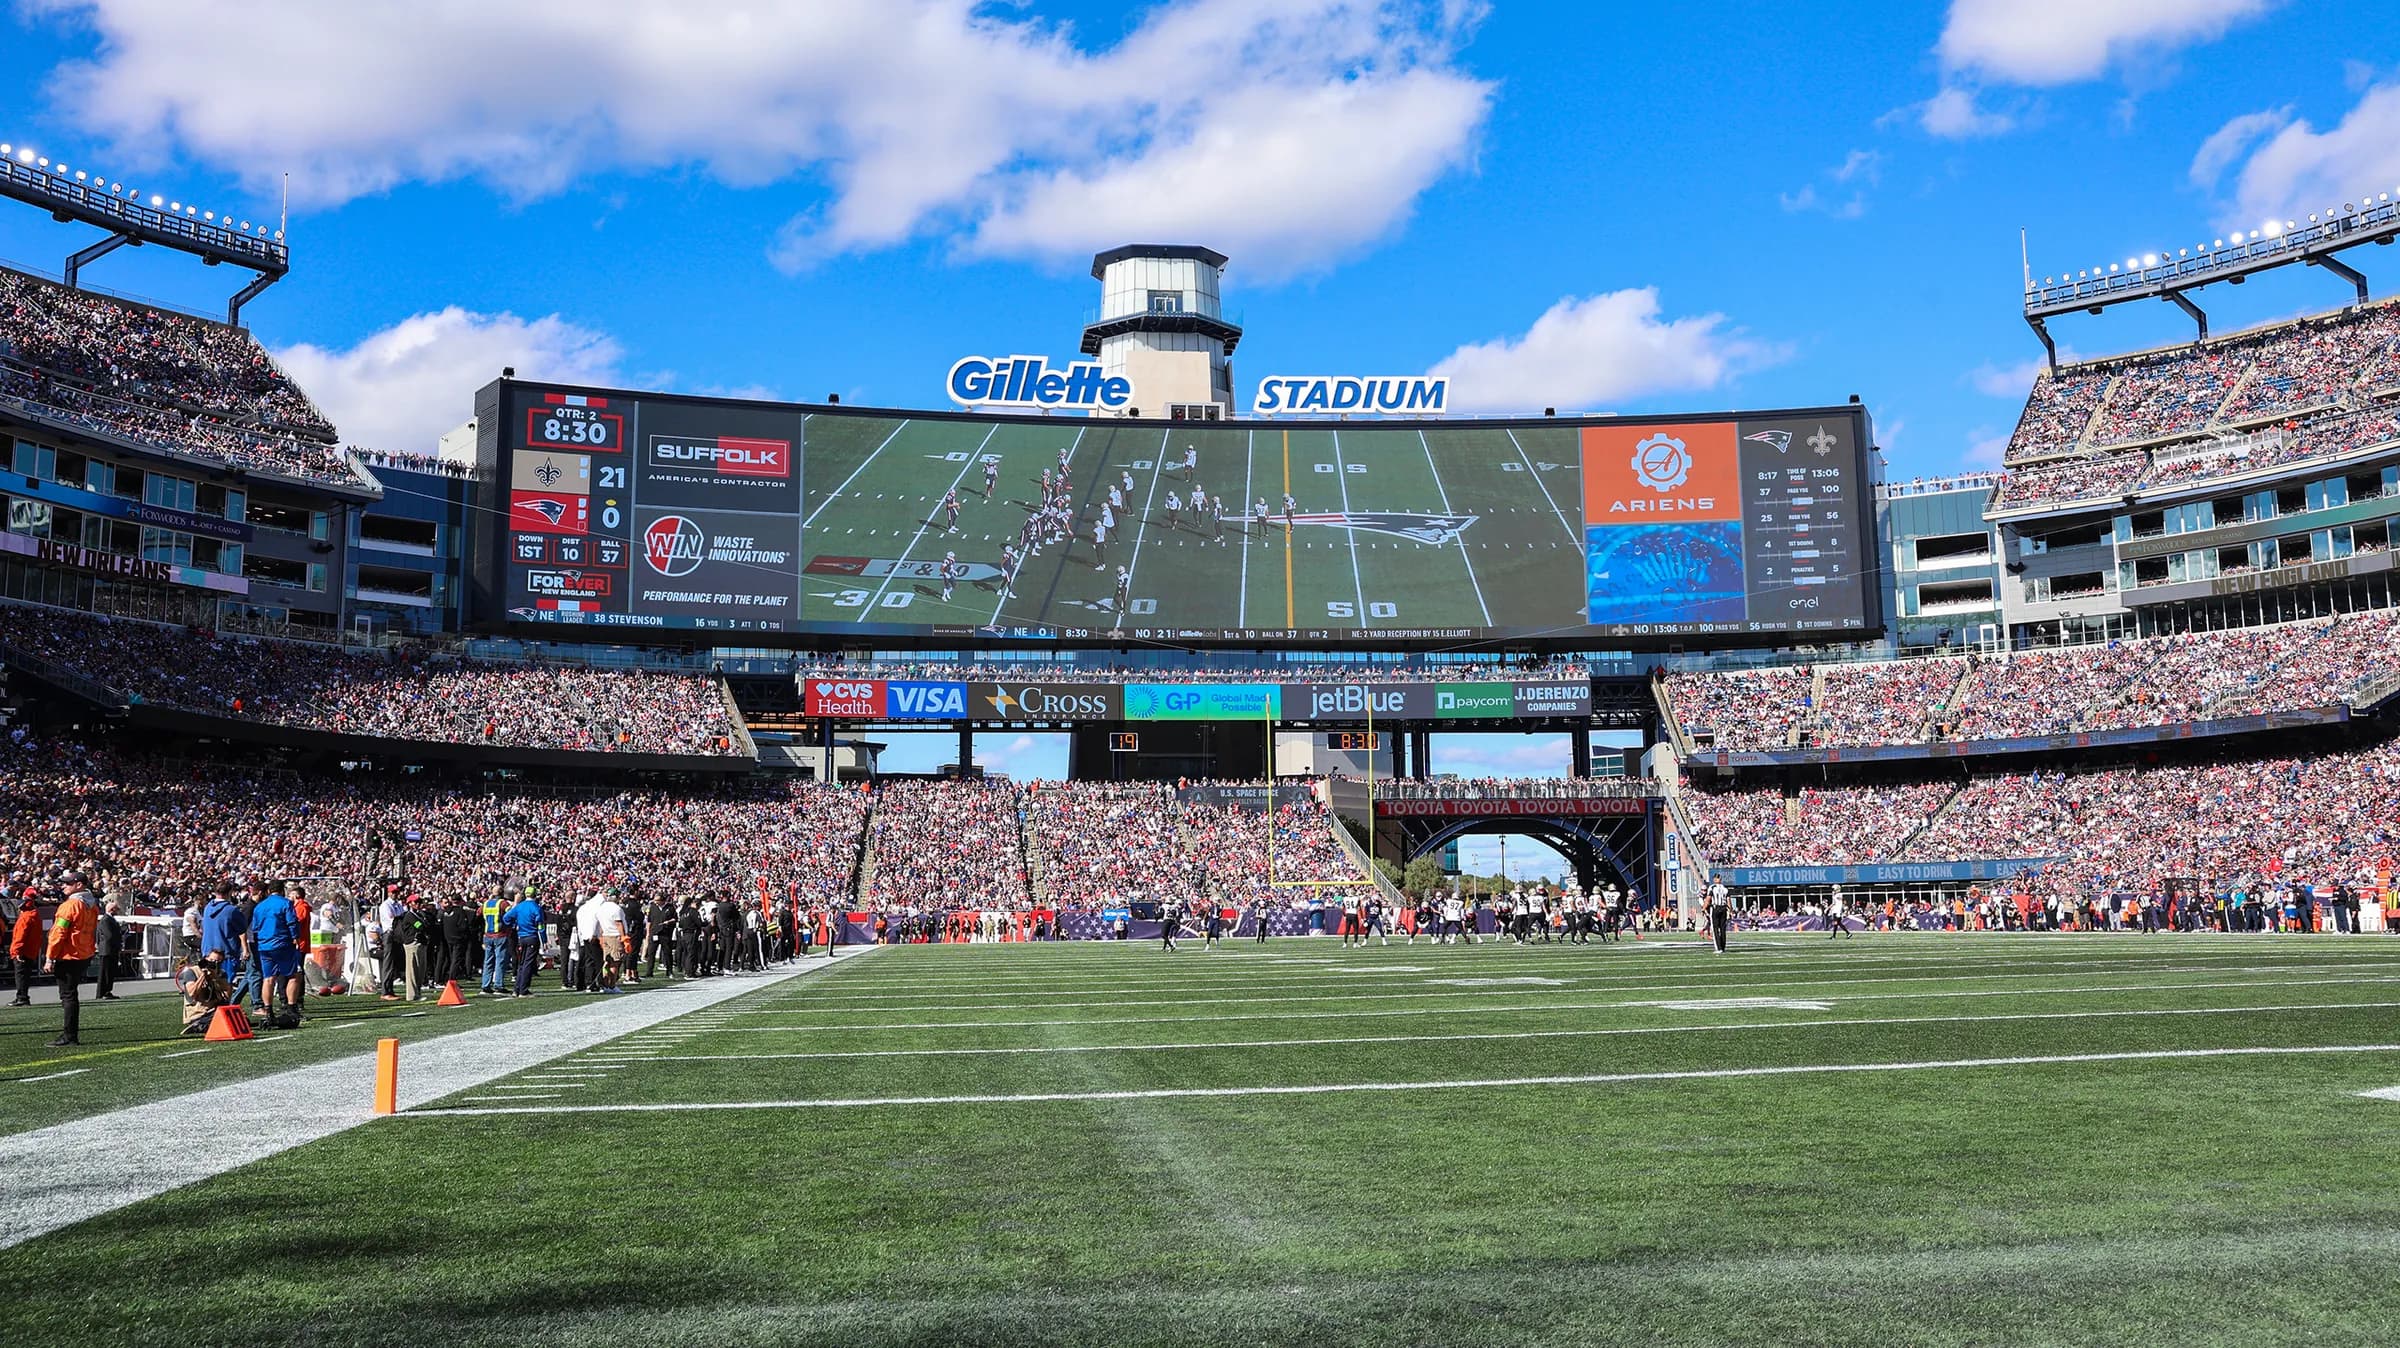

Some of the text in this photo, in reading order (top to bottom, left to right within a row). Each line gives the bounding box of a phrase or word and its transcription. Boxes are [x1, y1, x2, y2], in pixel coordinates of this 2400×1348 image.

[950, 357, 1446, 411] Gillette STADIUM
[555, 408, 597, 420] QTR: 2
[544, 419, 607, 444] 8:30
[656, 444, 778, 465] SUFFOLK
[599, 466, 625, 489] 21
[649, 474, 786, 488] AMERICA'S CONTRACTOR
[1758, 472, 1778, 480] 8:17
[1812, 469, 1839, 478] 13:06
[1760, 488, 1771, 496] 37
[1822, 485, 1839, 493] 100
[1609, 497, 1713, 513] ARIENS
[141, 508, 186, 526] FOXWOODS
[218, 526, 241, 535] CASINO
[602, 508, 620, 529] 0
[519, 535, 620, 548] DOWN DIST BALL
[713, 535, 754, 549] WASTE
[39, 539, 171, 582] NEW ORLEANS
[518, 545, 619, 563] 1ST 10 37
[708, 548, 786, 564] INNOVATIONS
[915, 563, 933, 576] &
[1767, 567, 1773, 575] 2
[2212, 560, 2349, 594] NEW ENGLAND
[541, 588, 596, 598] NEW ENGLAND
[643, 590, 788, 607] PERFORMANCE FOR THE PLANET
[1789, 596, 1819, 608] enel
[539, 610, 554, 621] NE
[562, 616, 583, 624] LEADER
[594, 613, 663, 626] 38 STEVENSON
[695, 618, 705, 628] 16
[729, 619, 735, 629] 3
[741, 620, 751, 628] ATT
[760, 620, 767, 630] 0
[1634, 624, 1649, 634] NO
[1654, 624, 1678, 633] 13:06
[1699, 623, 1714, 632] 100
[1750, 622, 1760, 630] 56
[1797, 620, 1802, 629] 8
[1843, 619, 1849, 627] 5
[1014, 627, 1171, 638] NE 0 8:30 NO 21
[1224, 630, 1234, 639] 1ST
[1245, 630, 1255, 639] 10
[1287, 630, 1297, 639] 37
[1309, 631, 1320, 639] QTR
[1322, 630, 1328, 639] 2
[1352, 630, 1362, 638] NE:
[1369, 630, 1386, 638] YARD
[1387, 630, 1421, 638] RECEPTION
[1423, 630, 1431, 638] BY
[834, 683, 873, 698] CVS
[1515, 686, 1589, 701] J.DERENZO
[890, 687, 964, 713] VISA
[1019, 687, 1106, 714] CROSS
[1211, 694, 1244, 702] Global
[1310, 686, 1404, 718] jetBlue
[1457, 696, 1509, 710] paycom
[1221, 703, 1262, 711] Possible
[1527, 702, 1577, 712] COMPANIES
[1119, 735, 1135, 749] 19
[1342, 733, 1376, 749] 8:30
[1731, 755, 1758, 763] TOYOTA
[1220, 789, 1234, 797] U.S.
[1236, 789, 1257, 797] SPACE
[1386, 800, 1641, 815] TOYOTA TOYOTA TOYOTA TOYOTA
[1748, 871, 1776, 882] EASY
[1777, 870, 1793, 882] TO
[1793, 869, 1828, 881] DRINK
[1878, 865, 1953, 880] EASY TO DRINK
[1450, 902, 1460, 911] 97
[225, 1008, 250, 1035] 10
